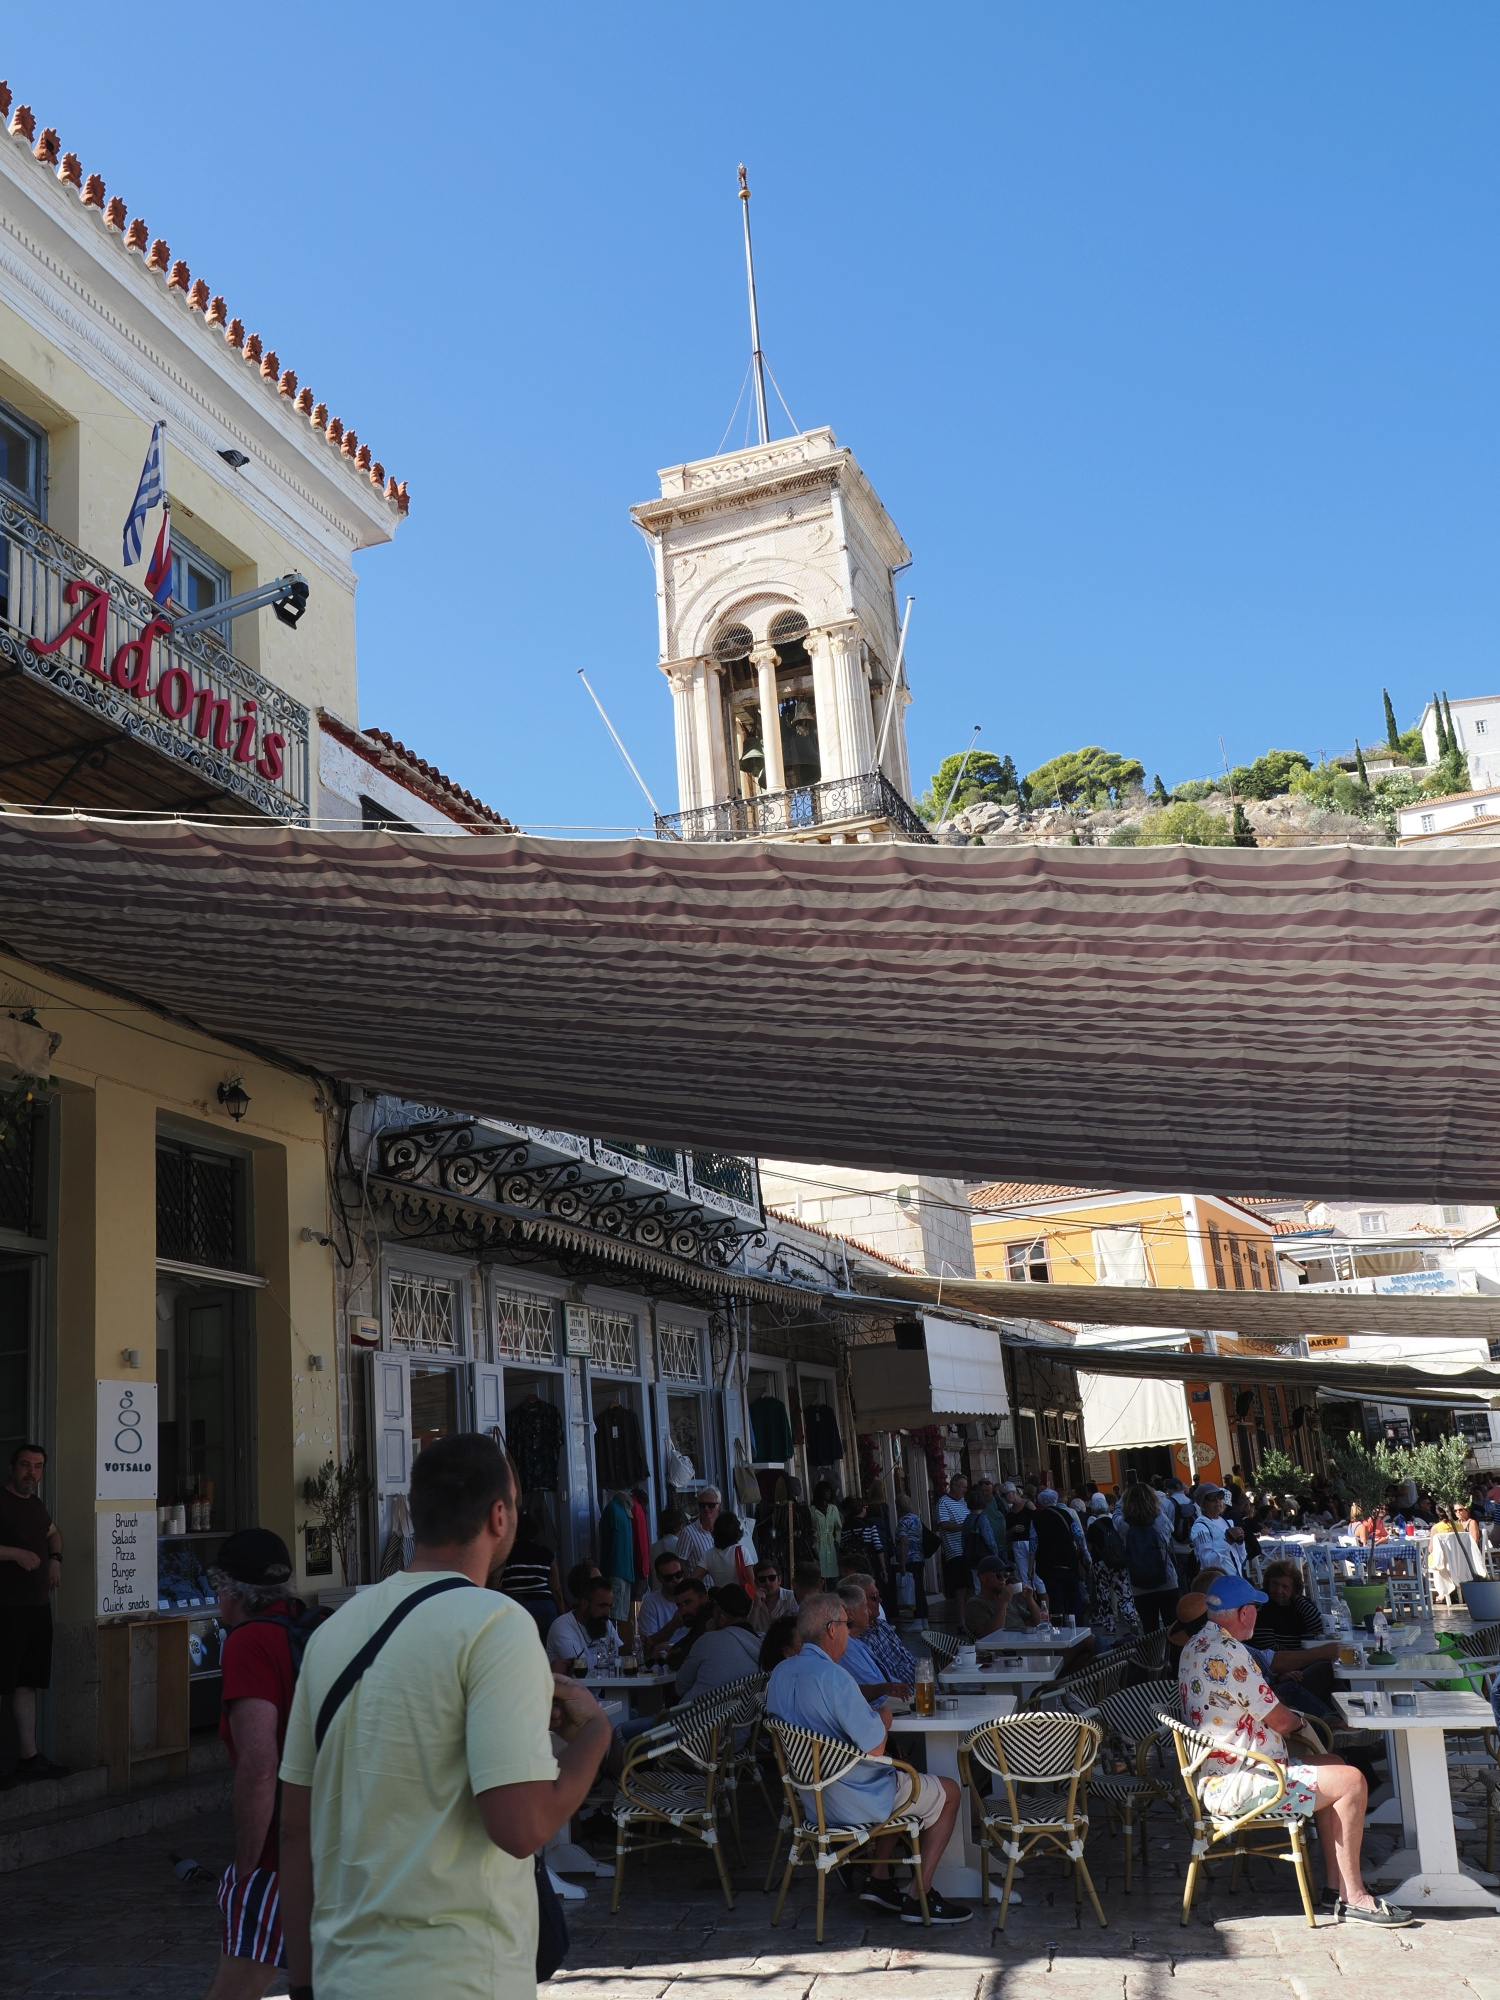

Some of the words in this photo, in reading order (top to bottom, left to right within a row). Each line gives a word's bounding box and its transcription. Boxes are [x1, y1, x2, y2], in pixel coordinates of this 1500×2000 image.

[27, 581, 286, 780] Adonis
[1391, 1272, 1444, 1284] RESTAURANT
[105, 1463, 151, 1472] VOTSALO
[115, 1513, 138, 1528] Brunch
[112, 1530, 136, 1545] Salads
[116, 1546, 136, 1560] Pizza
[111, 1563, 136, 1580] Burger
[113, 1580, 133, 1594] Pasta
[103, 1596, 124, 1612] Quick
[128, 1594, 150, 1610] snacks
